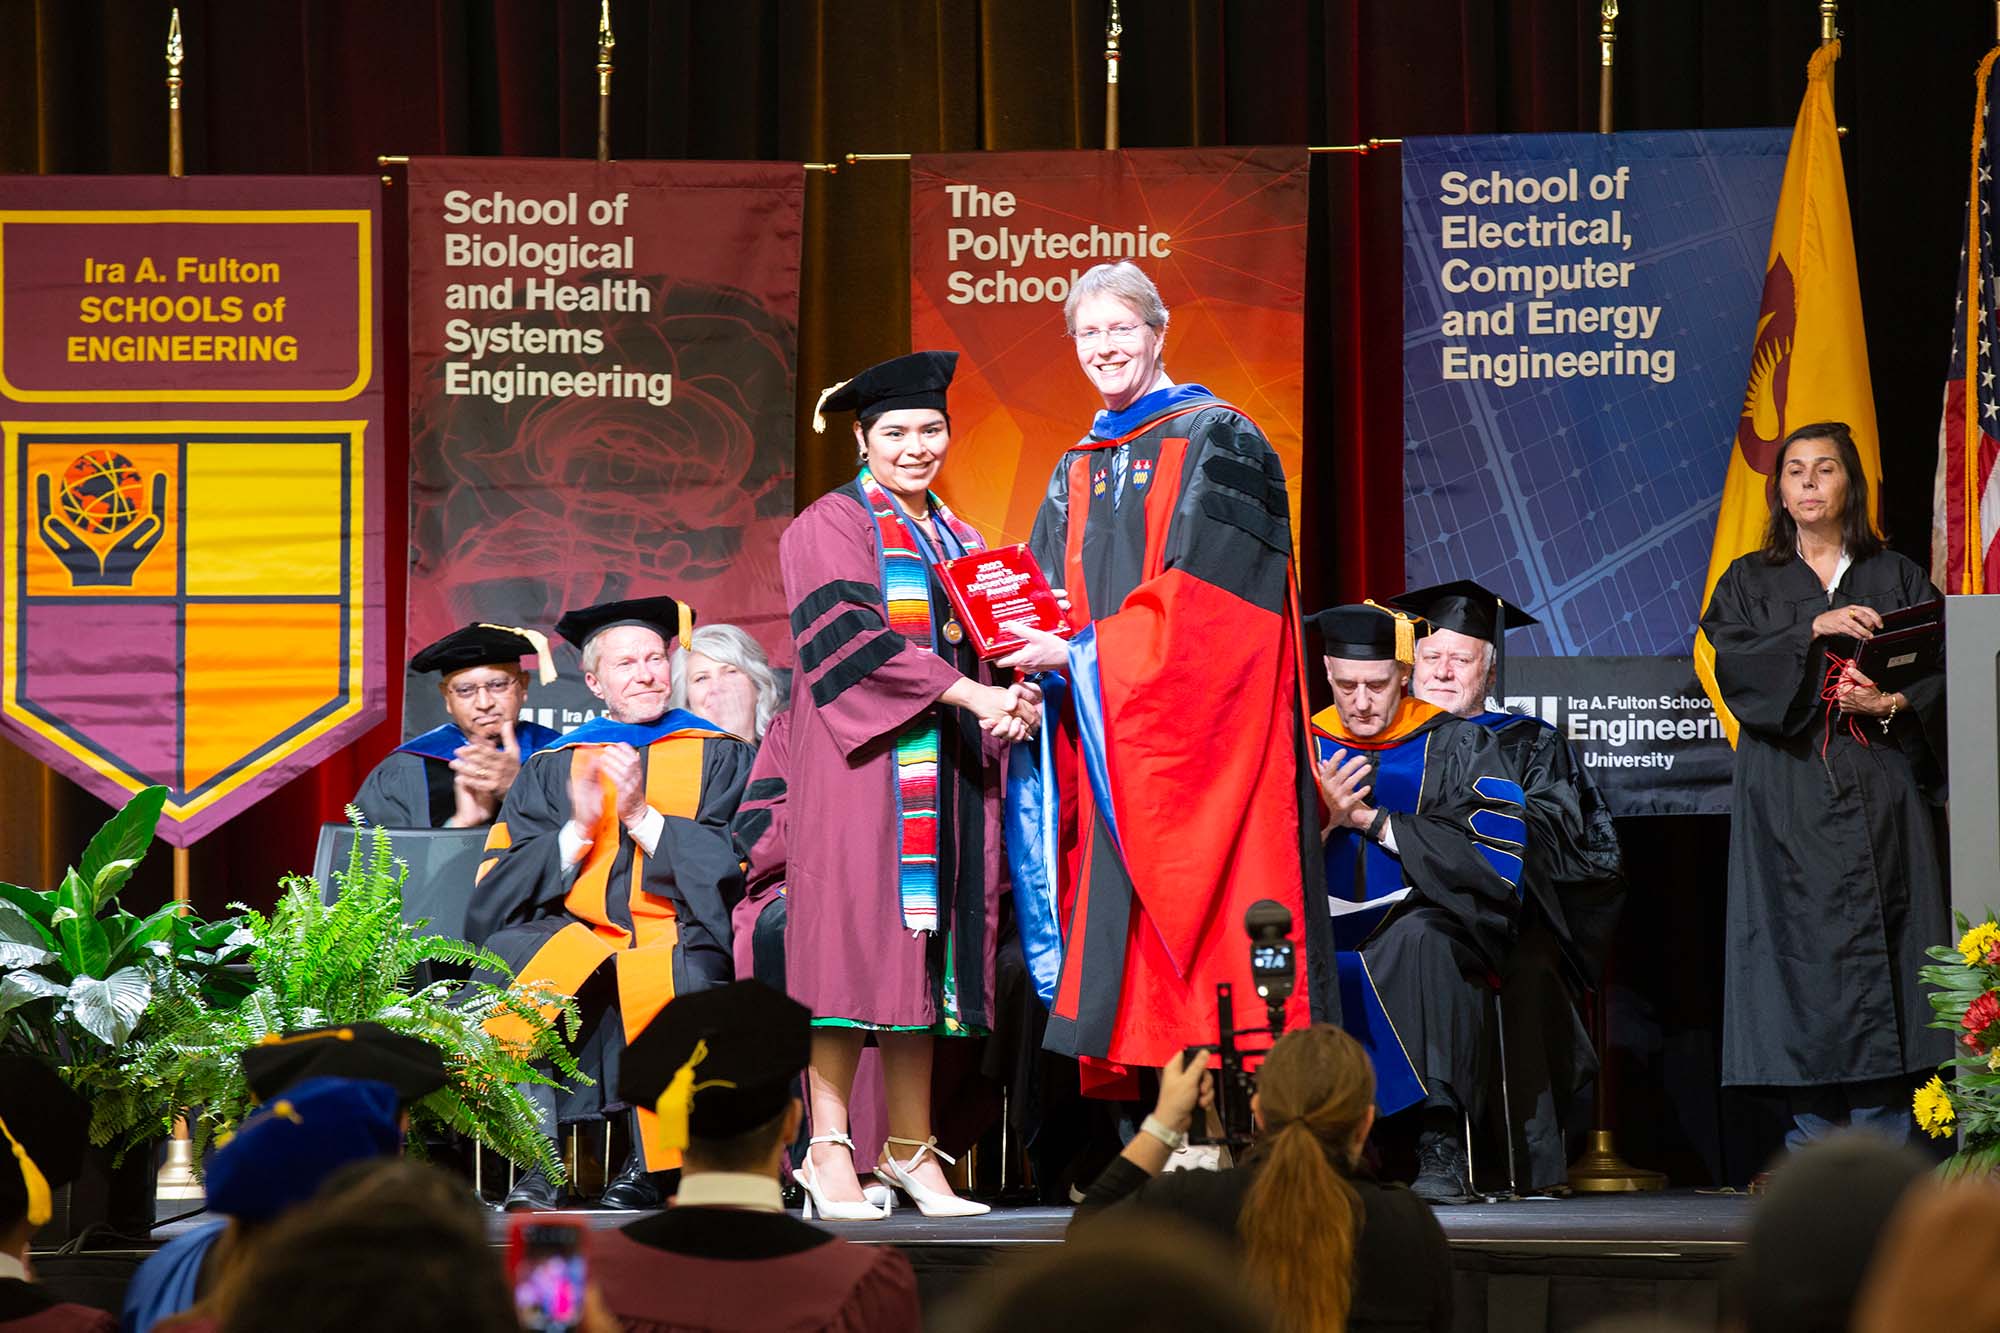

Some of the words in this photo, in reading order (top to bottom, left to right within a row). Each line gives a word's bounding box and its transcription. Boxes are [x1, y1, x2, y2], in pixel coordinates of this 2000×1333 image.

[945, 185, 1016, 218] The
[1440, 168, 1578, 205] School
[1589, 166, 1630, 200] of
[443, 190, 577, 225] School
[588, 193, 629, 226] of
[948, 225, 1172, 267] Polytechnic
[1442, 210, 1632, 250] Electrical,
[84, 257, 126, 284] Ira
[135, 256, 167, 283] A.
[177, 256, 280, 284] Fulton
[445, 233, 634, 275] Biological
[445, 277, 513, 310] and
[526, 278, 651, 312] Health
[1441, 257, 1635, 298] Computer
[79, 296, 243, 323] SCHOOLS
[252, 296, 287, 323] of
[1441, 302, 1514, 336] and
[1528, 301, 1661, 339] Energy
[67, 336, 298, 362] ENGINEERING
[444, 319, 605, 360] Systems
[1442, 343, 1676, 387] Engineering
[445, 362, 672, 406] Engineering
[562, 709, 582, 723] Ira
[1568, 696, 1588, 710] Ira
[1590, 696, 1606, 710] A.
[1607, 695, 1657, 710] Fulton
[1659, 695, 1714, 710] Schoo
[1584, 752, 1675, 770] University
